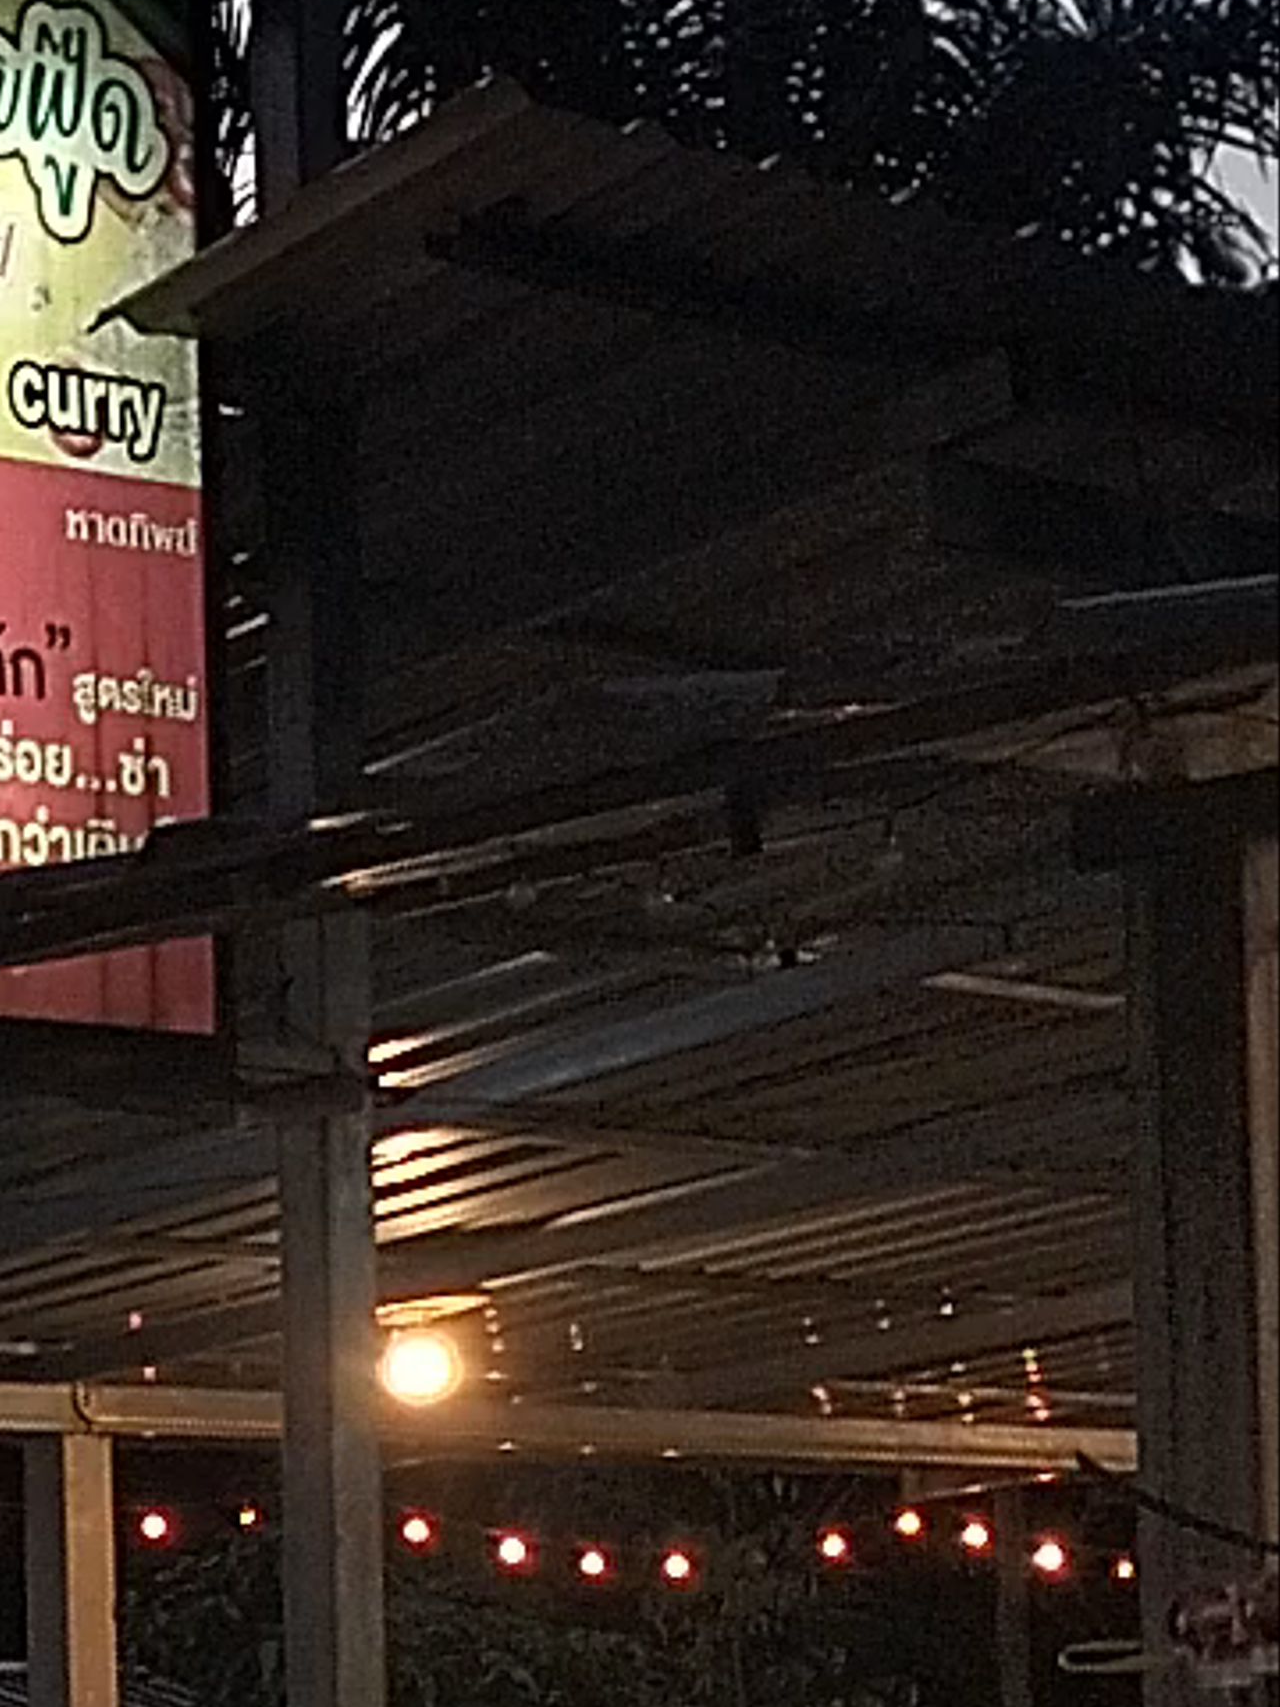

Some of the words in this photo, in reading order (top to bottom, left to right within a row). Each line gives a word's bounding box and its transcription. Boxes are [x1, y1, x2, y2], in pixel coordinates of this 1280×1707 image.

[9, 359, 165, 462] curry
[72, 667, 199, 726] สูตรใหม่
